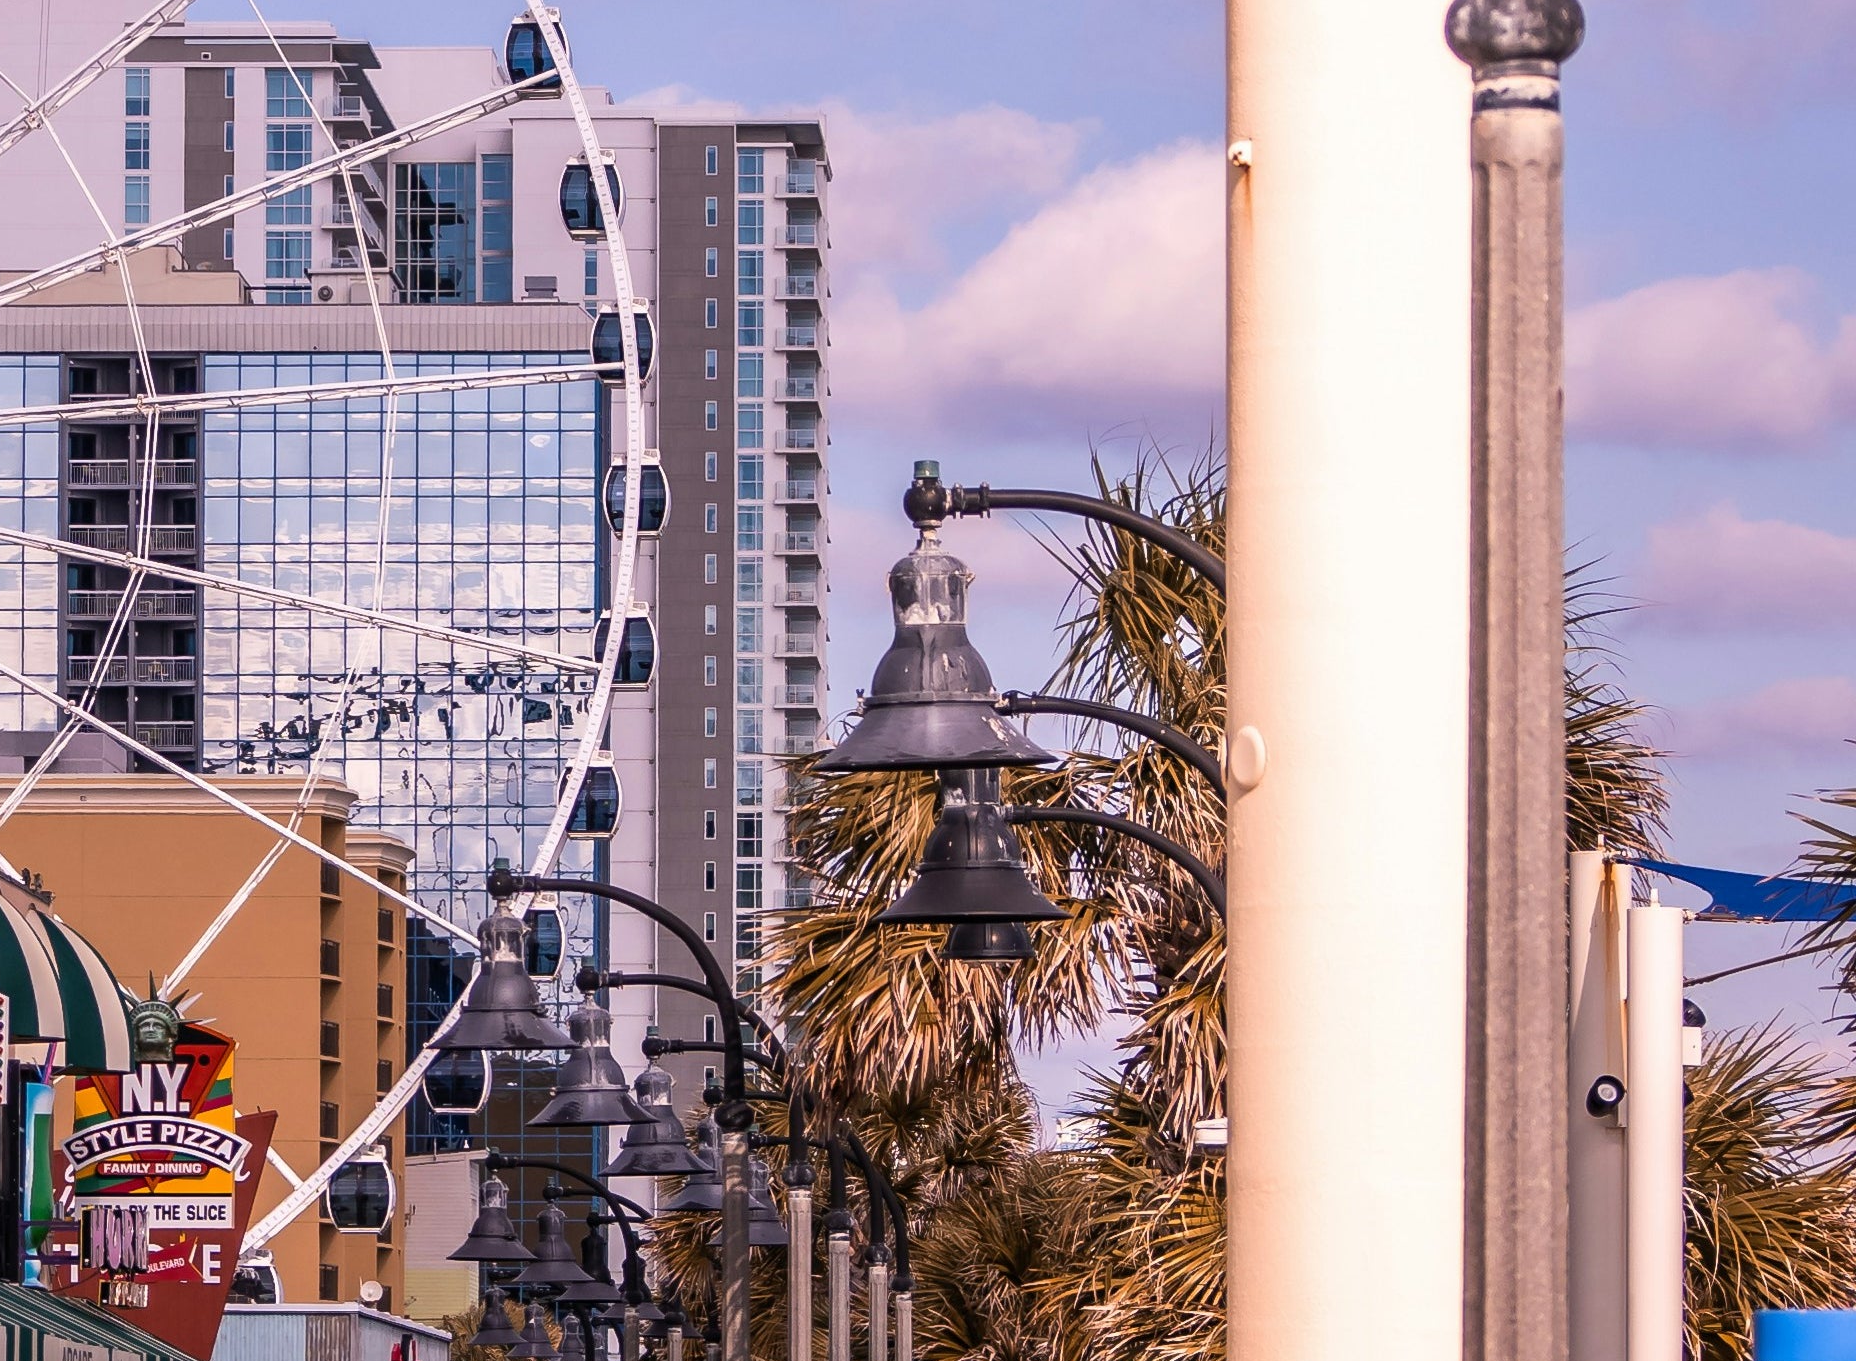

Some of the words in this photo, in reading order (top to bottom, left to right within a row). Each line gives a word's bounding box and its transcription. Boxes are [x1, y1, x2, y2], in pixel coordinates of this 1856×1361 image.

[122, 1063, 191, 1113] N.Y.
[70, 1123, 153, 1160] STYLE
[160, 1123, 234, 1160] PIZZA
[103, 1163, 151, 1174] FAMILY
[155, 1163, 202, 1174] DINING
[153, 1205, 180, 1220] THE
[186, 1205, 226, 1221] SLICE
